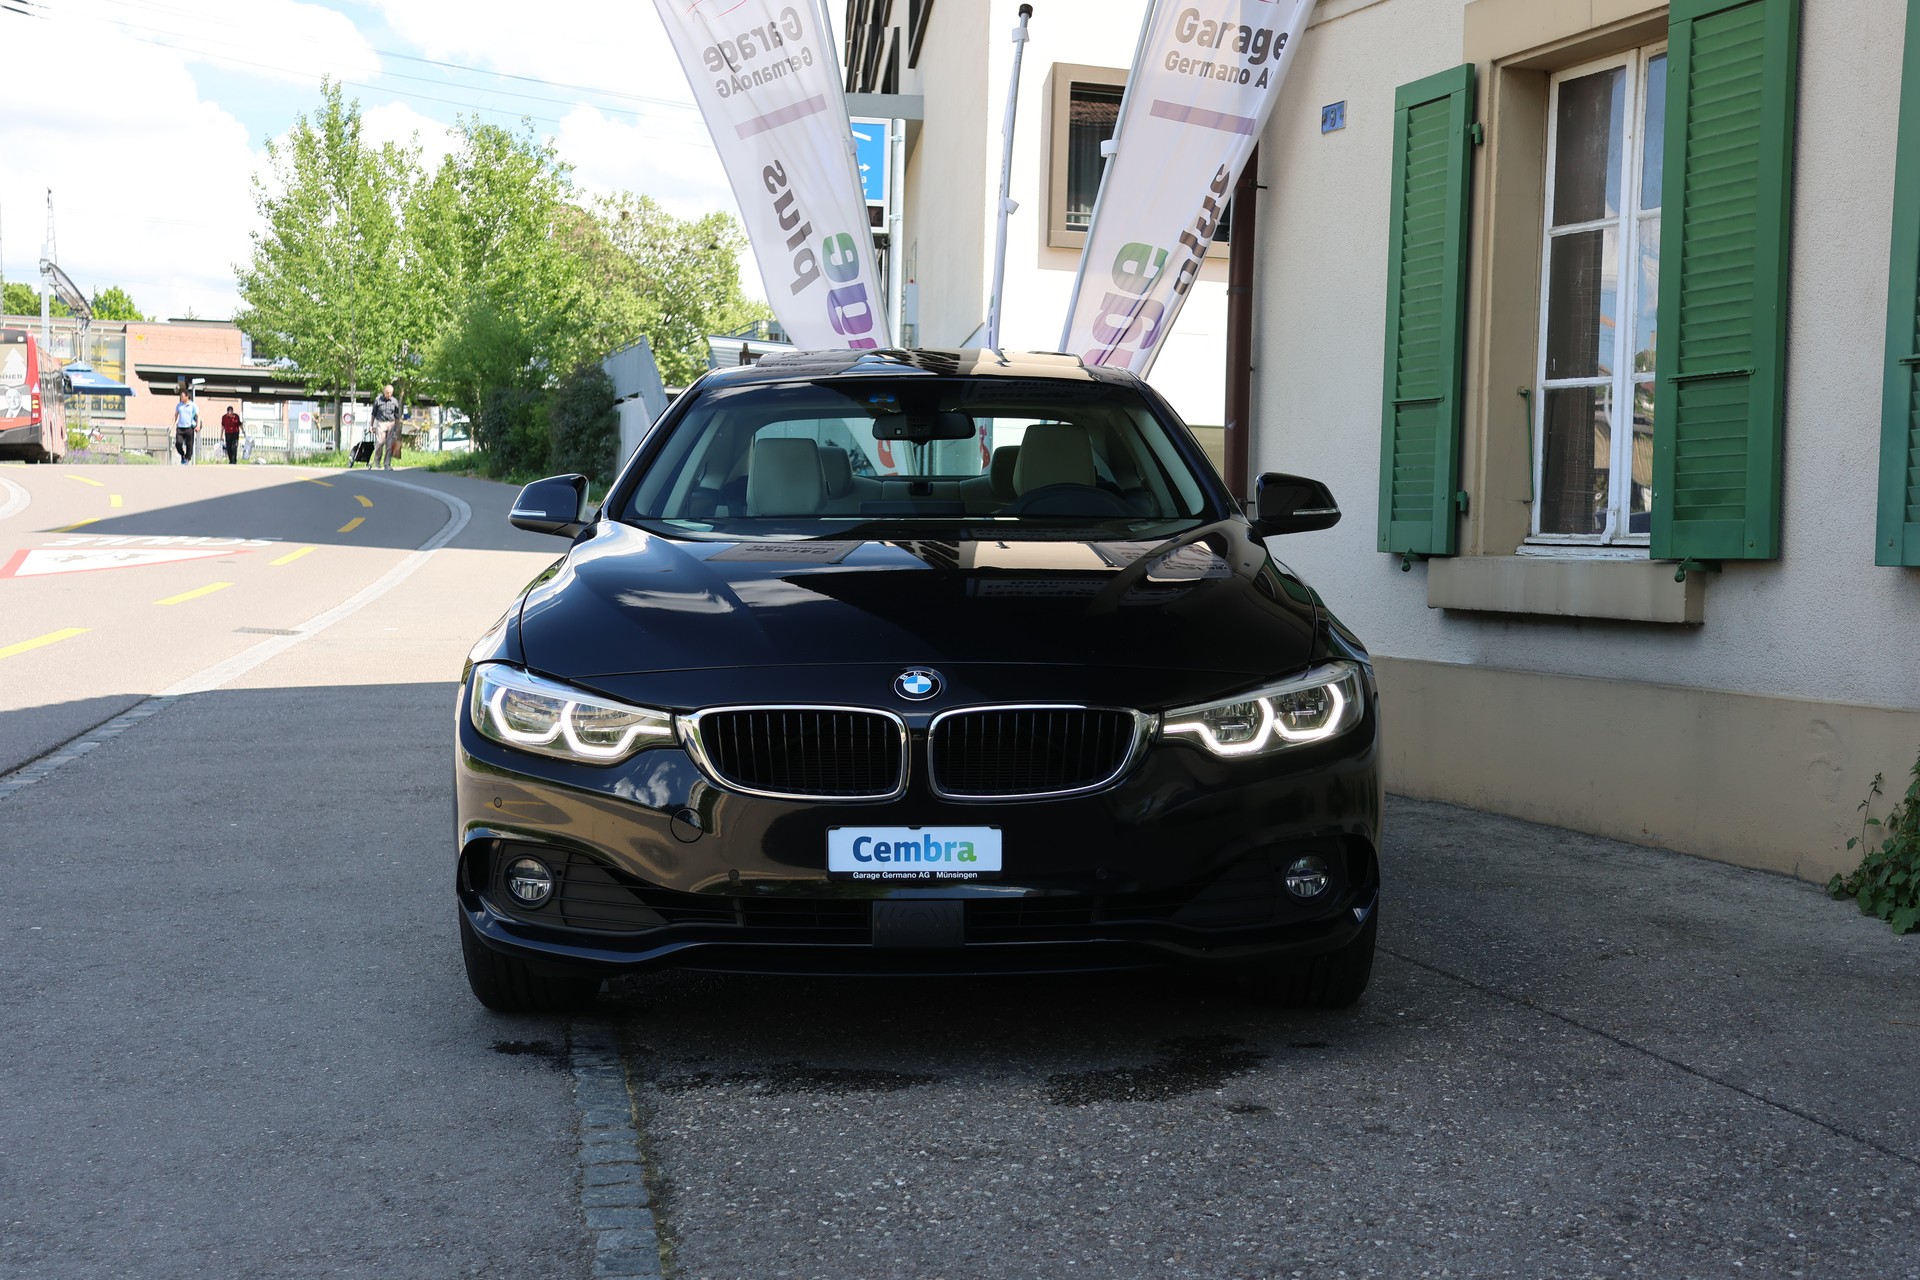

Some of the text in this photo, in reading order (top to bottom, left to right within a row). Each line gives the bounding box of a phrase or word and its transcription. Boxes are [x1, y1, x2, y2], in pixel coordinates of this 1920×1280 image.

[1175, 7, 1289, 65] Garage
[1164, 50, 1274, 89] Germano A
[42, 535, 283, 547] SCHULE
[852, 834, 977, 863] Cembra
[852, 872, 881, 880] Garage
[936, 871, 978, 880] Münsingen
